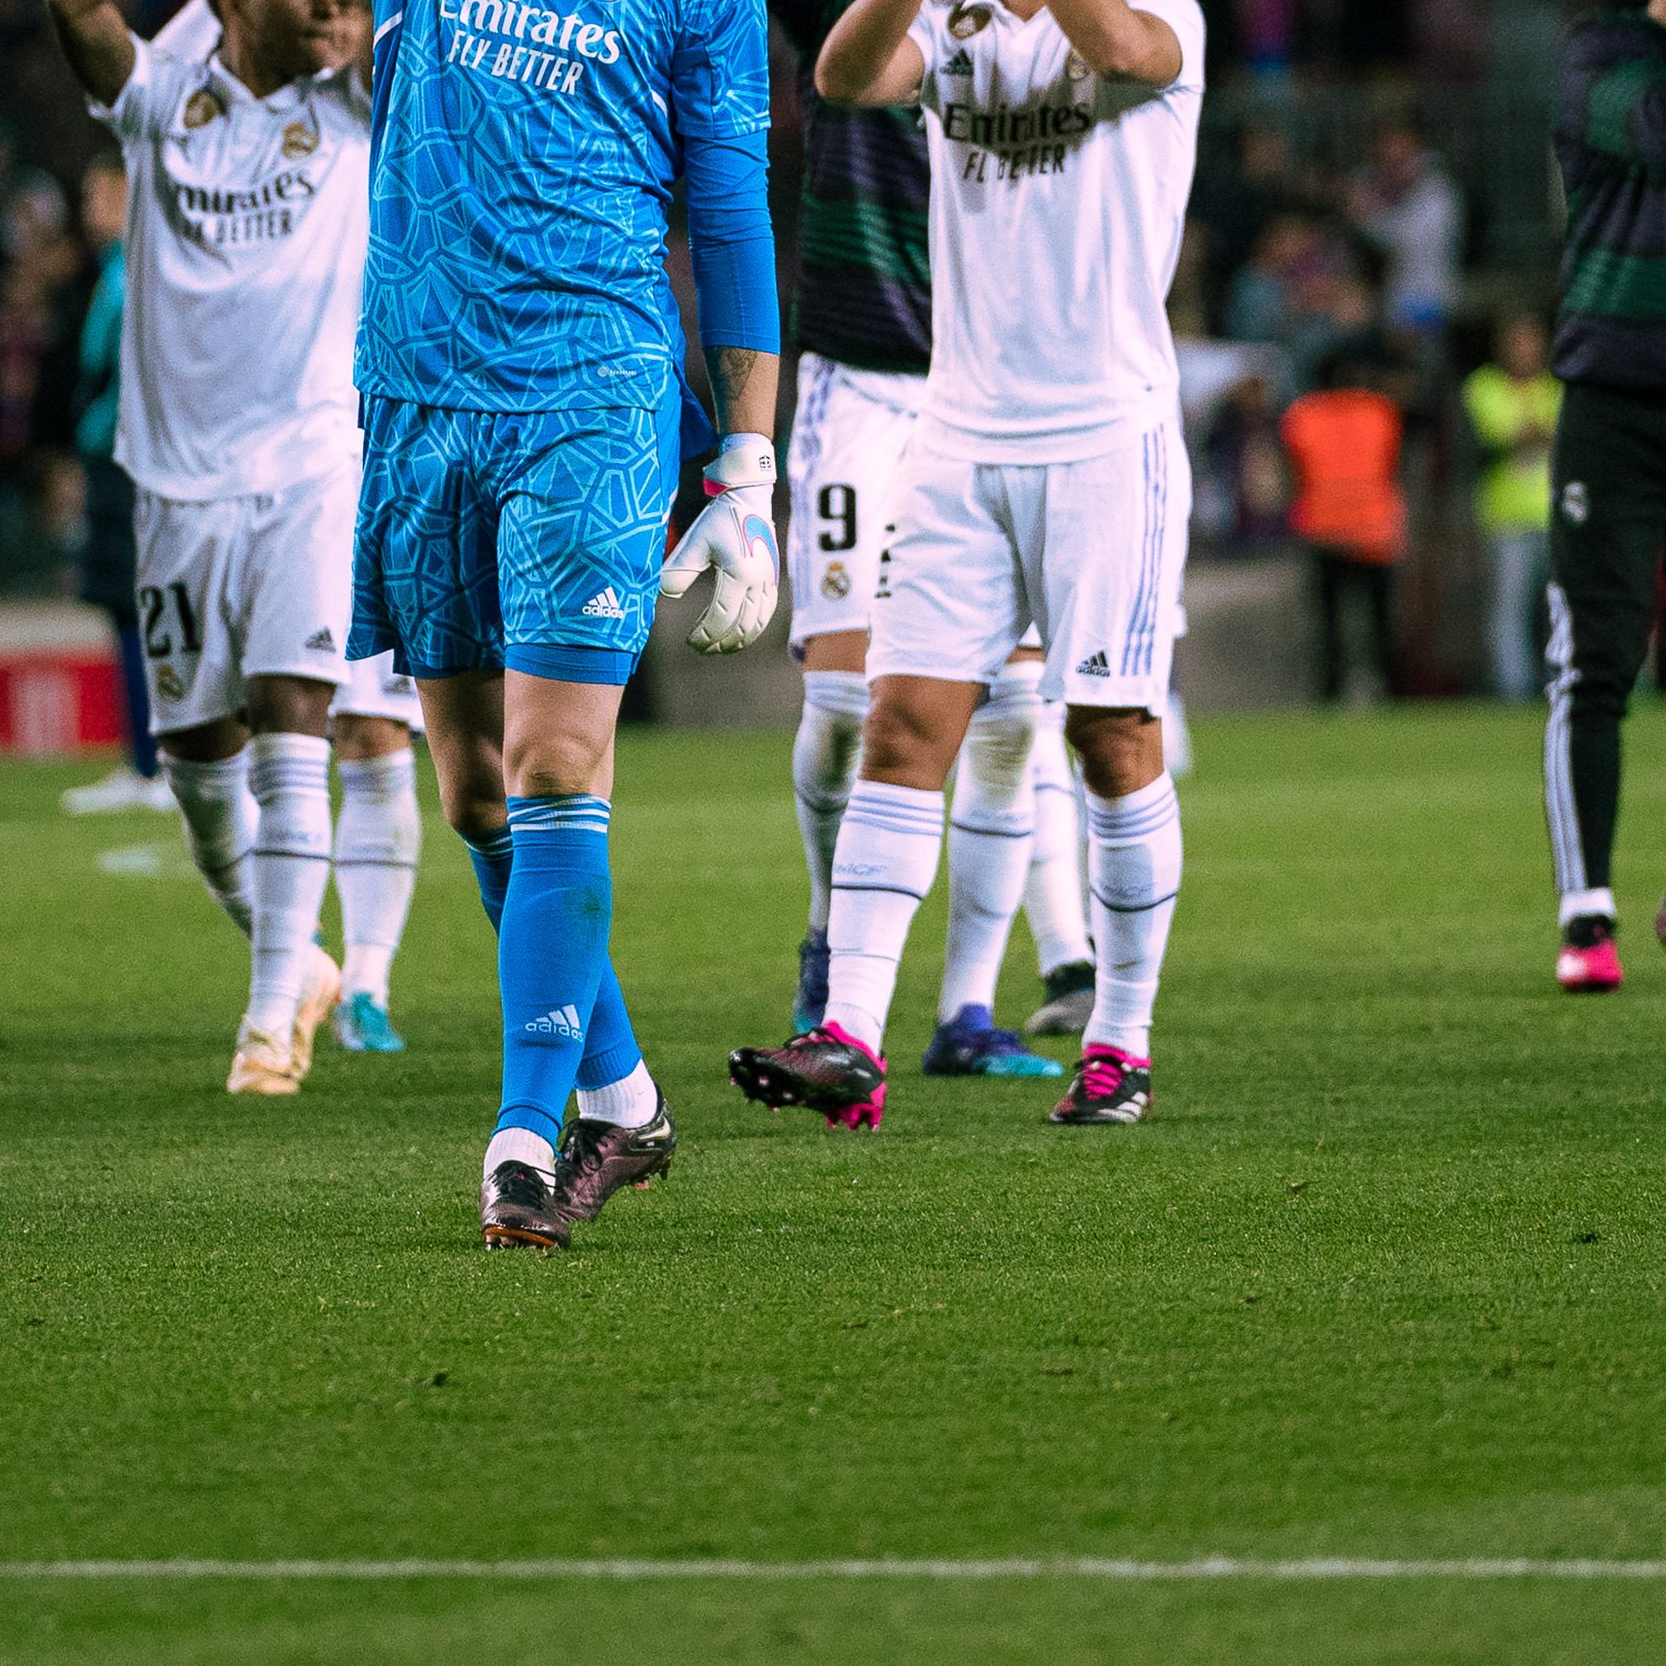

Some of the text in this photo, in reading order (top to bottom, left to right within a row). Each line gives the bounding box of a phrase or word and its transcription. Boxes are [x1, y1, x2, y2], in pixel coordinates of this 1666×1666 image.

[447, 30, 584, 95] FLY BETTER
[819, 483, 858, 551] 9
[139, 579, 200, 658] 21
[582, 603, 624, 619] adidas
[524, 1019, 584, 1043] adidas
